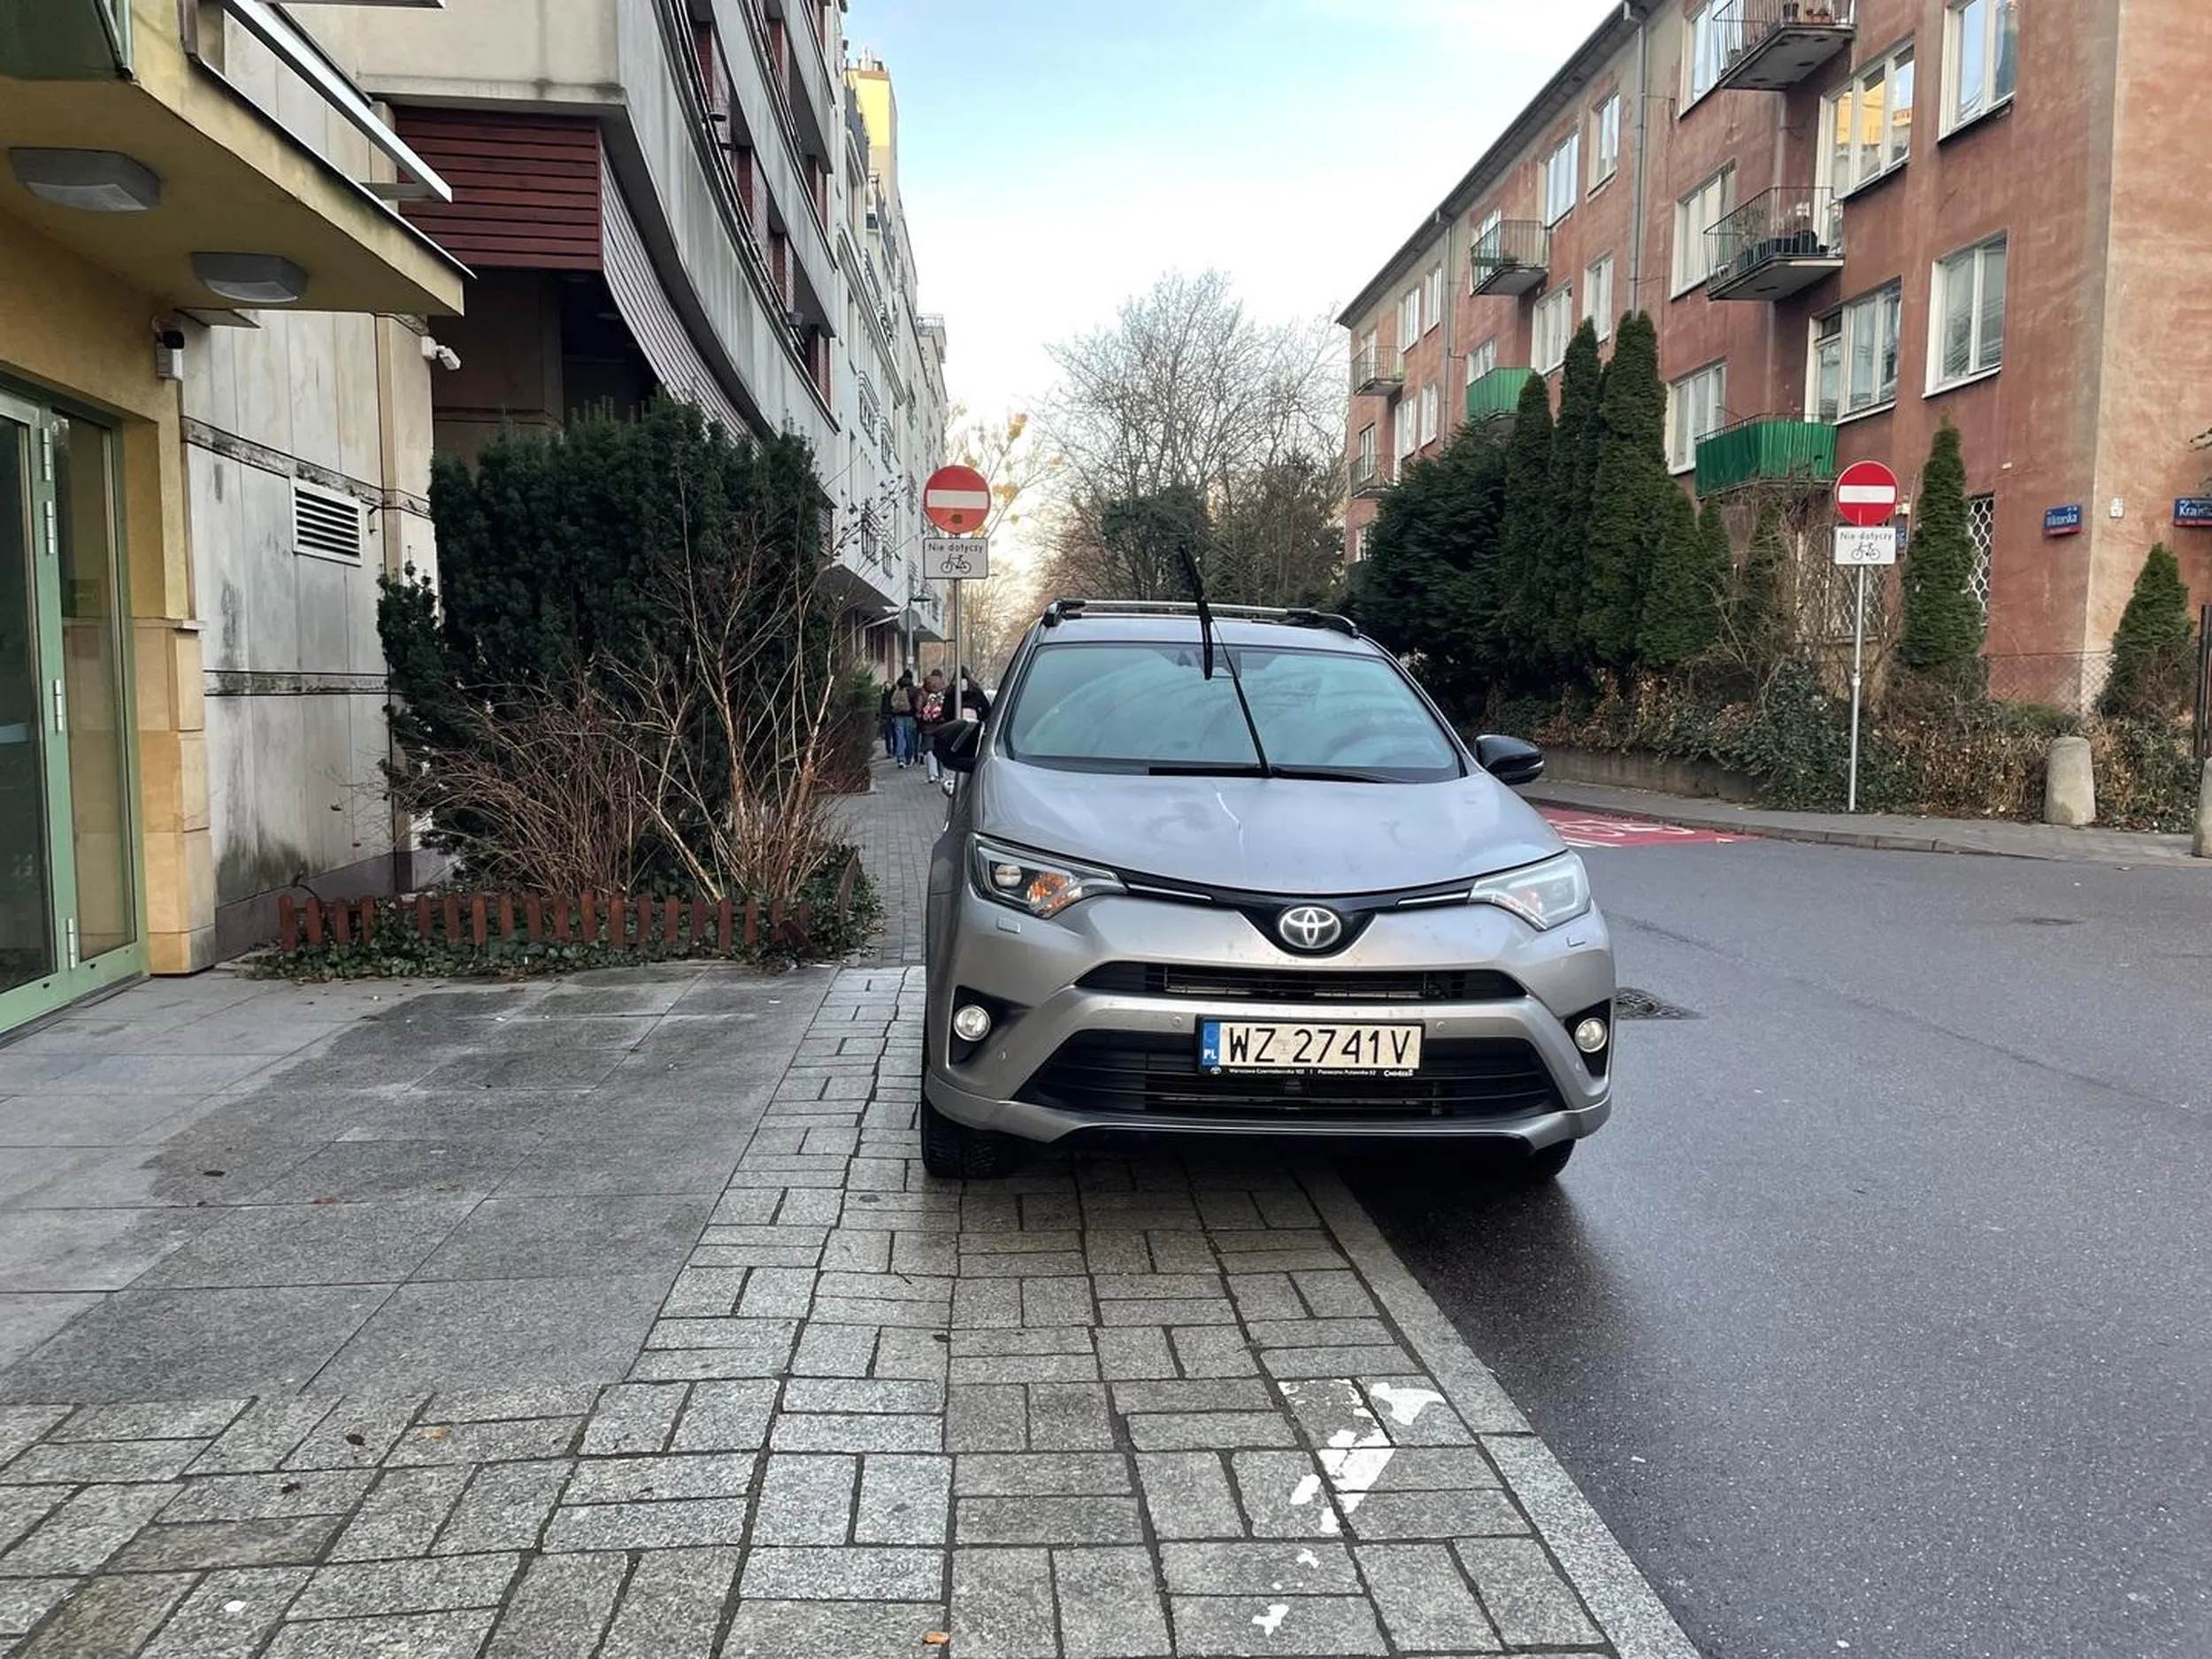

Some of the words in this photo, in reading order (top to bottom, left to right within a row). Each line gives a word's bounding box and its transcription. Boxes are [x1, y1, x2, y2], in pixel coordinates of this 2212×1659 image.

[928, 542, 944, 551] Nie
[948, 542, 984, 553] dotyczy
[1229, 1027, 1276, 1063] WZ
[1293, 1028, 1411, 1064] 2741V
[1203, 1048, 1217, 1059] PL
